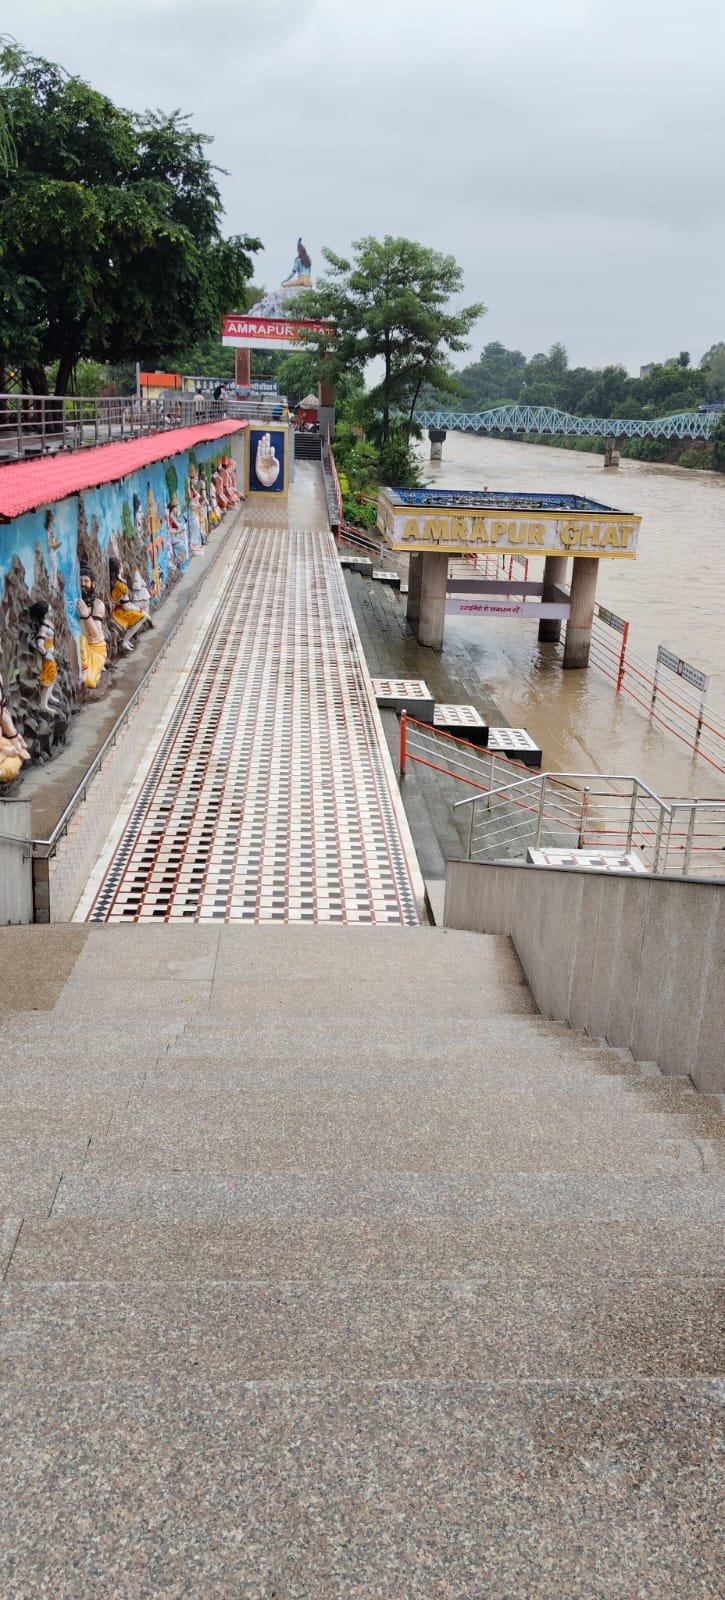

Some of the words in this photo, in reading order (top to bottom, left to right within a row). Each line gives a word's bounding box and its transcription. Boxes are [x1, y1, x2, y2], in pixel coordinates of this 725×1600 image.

[227, 323, 294, 336] AMRAPUR
[402, 518, 546, 545] AMRAPUR
[560, 523, 634, 548] GHAT
